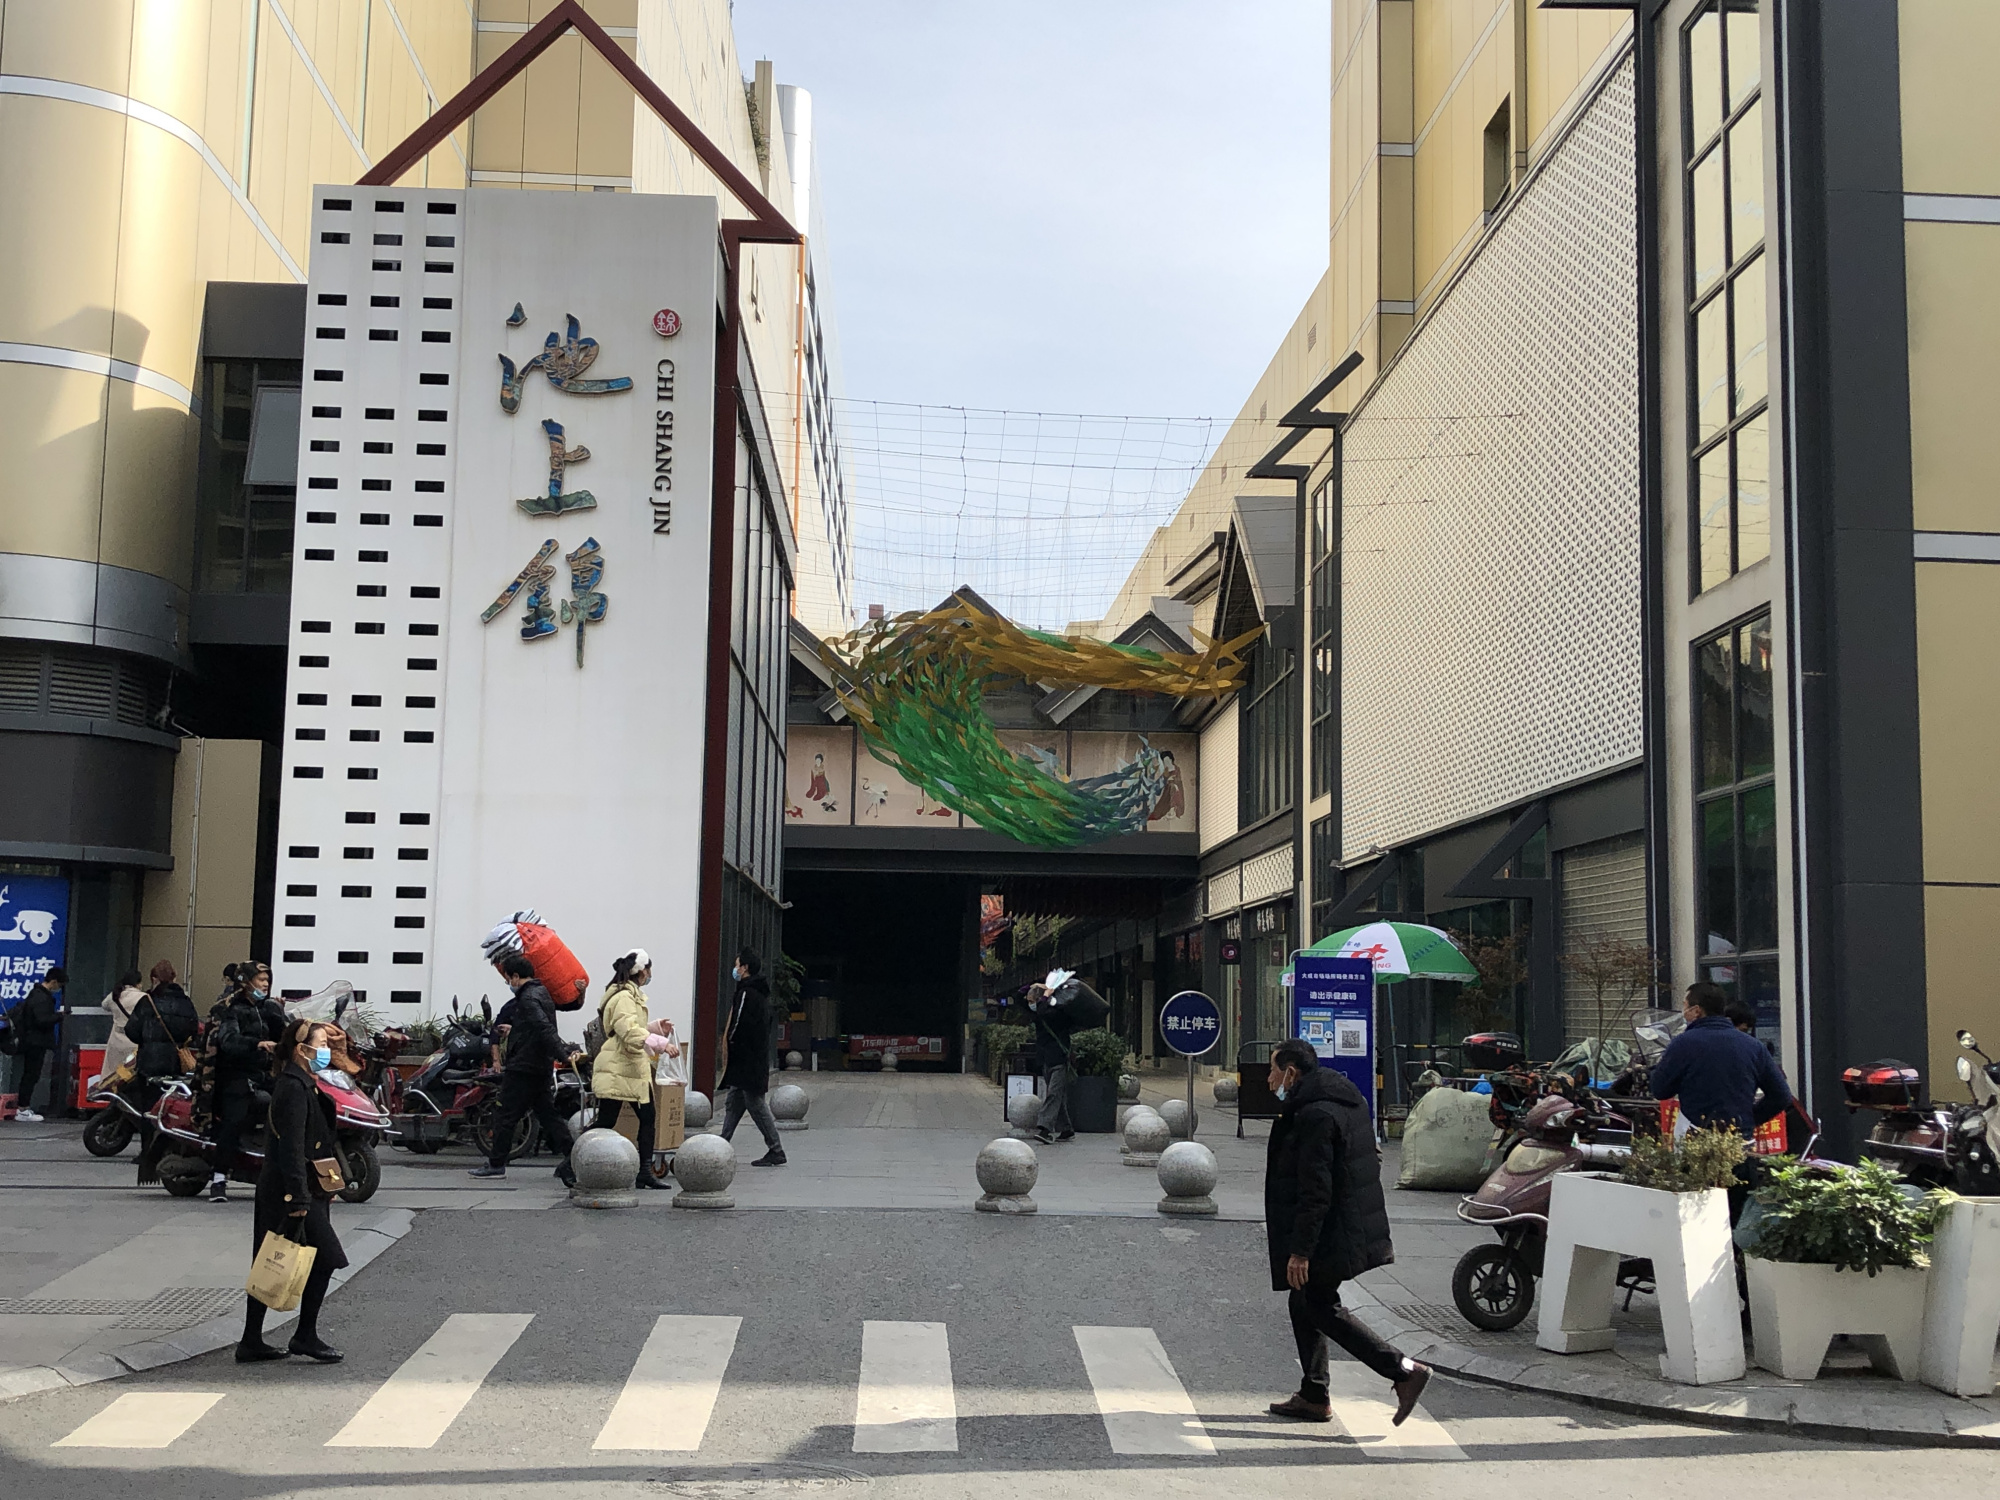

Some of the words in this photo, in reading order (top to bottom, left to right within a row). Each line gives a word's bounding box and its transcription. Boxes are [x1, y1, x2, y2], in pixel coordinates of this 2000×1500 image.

[656, 358, 675, 402] CHI
[654, 410, 674, 492] SHANG
[649, 497, 671, 536] JIN
[1309, 991, 1357, 1001] 请出示健康码
[1166, 1015, 1217, 1031] 禁止停车
